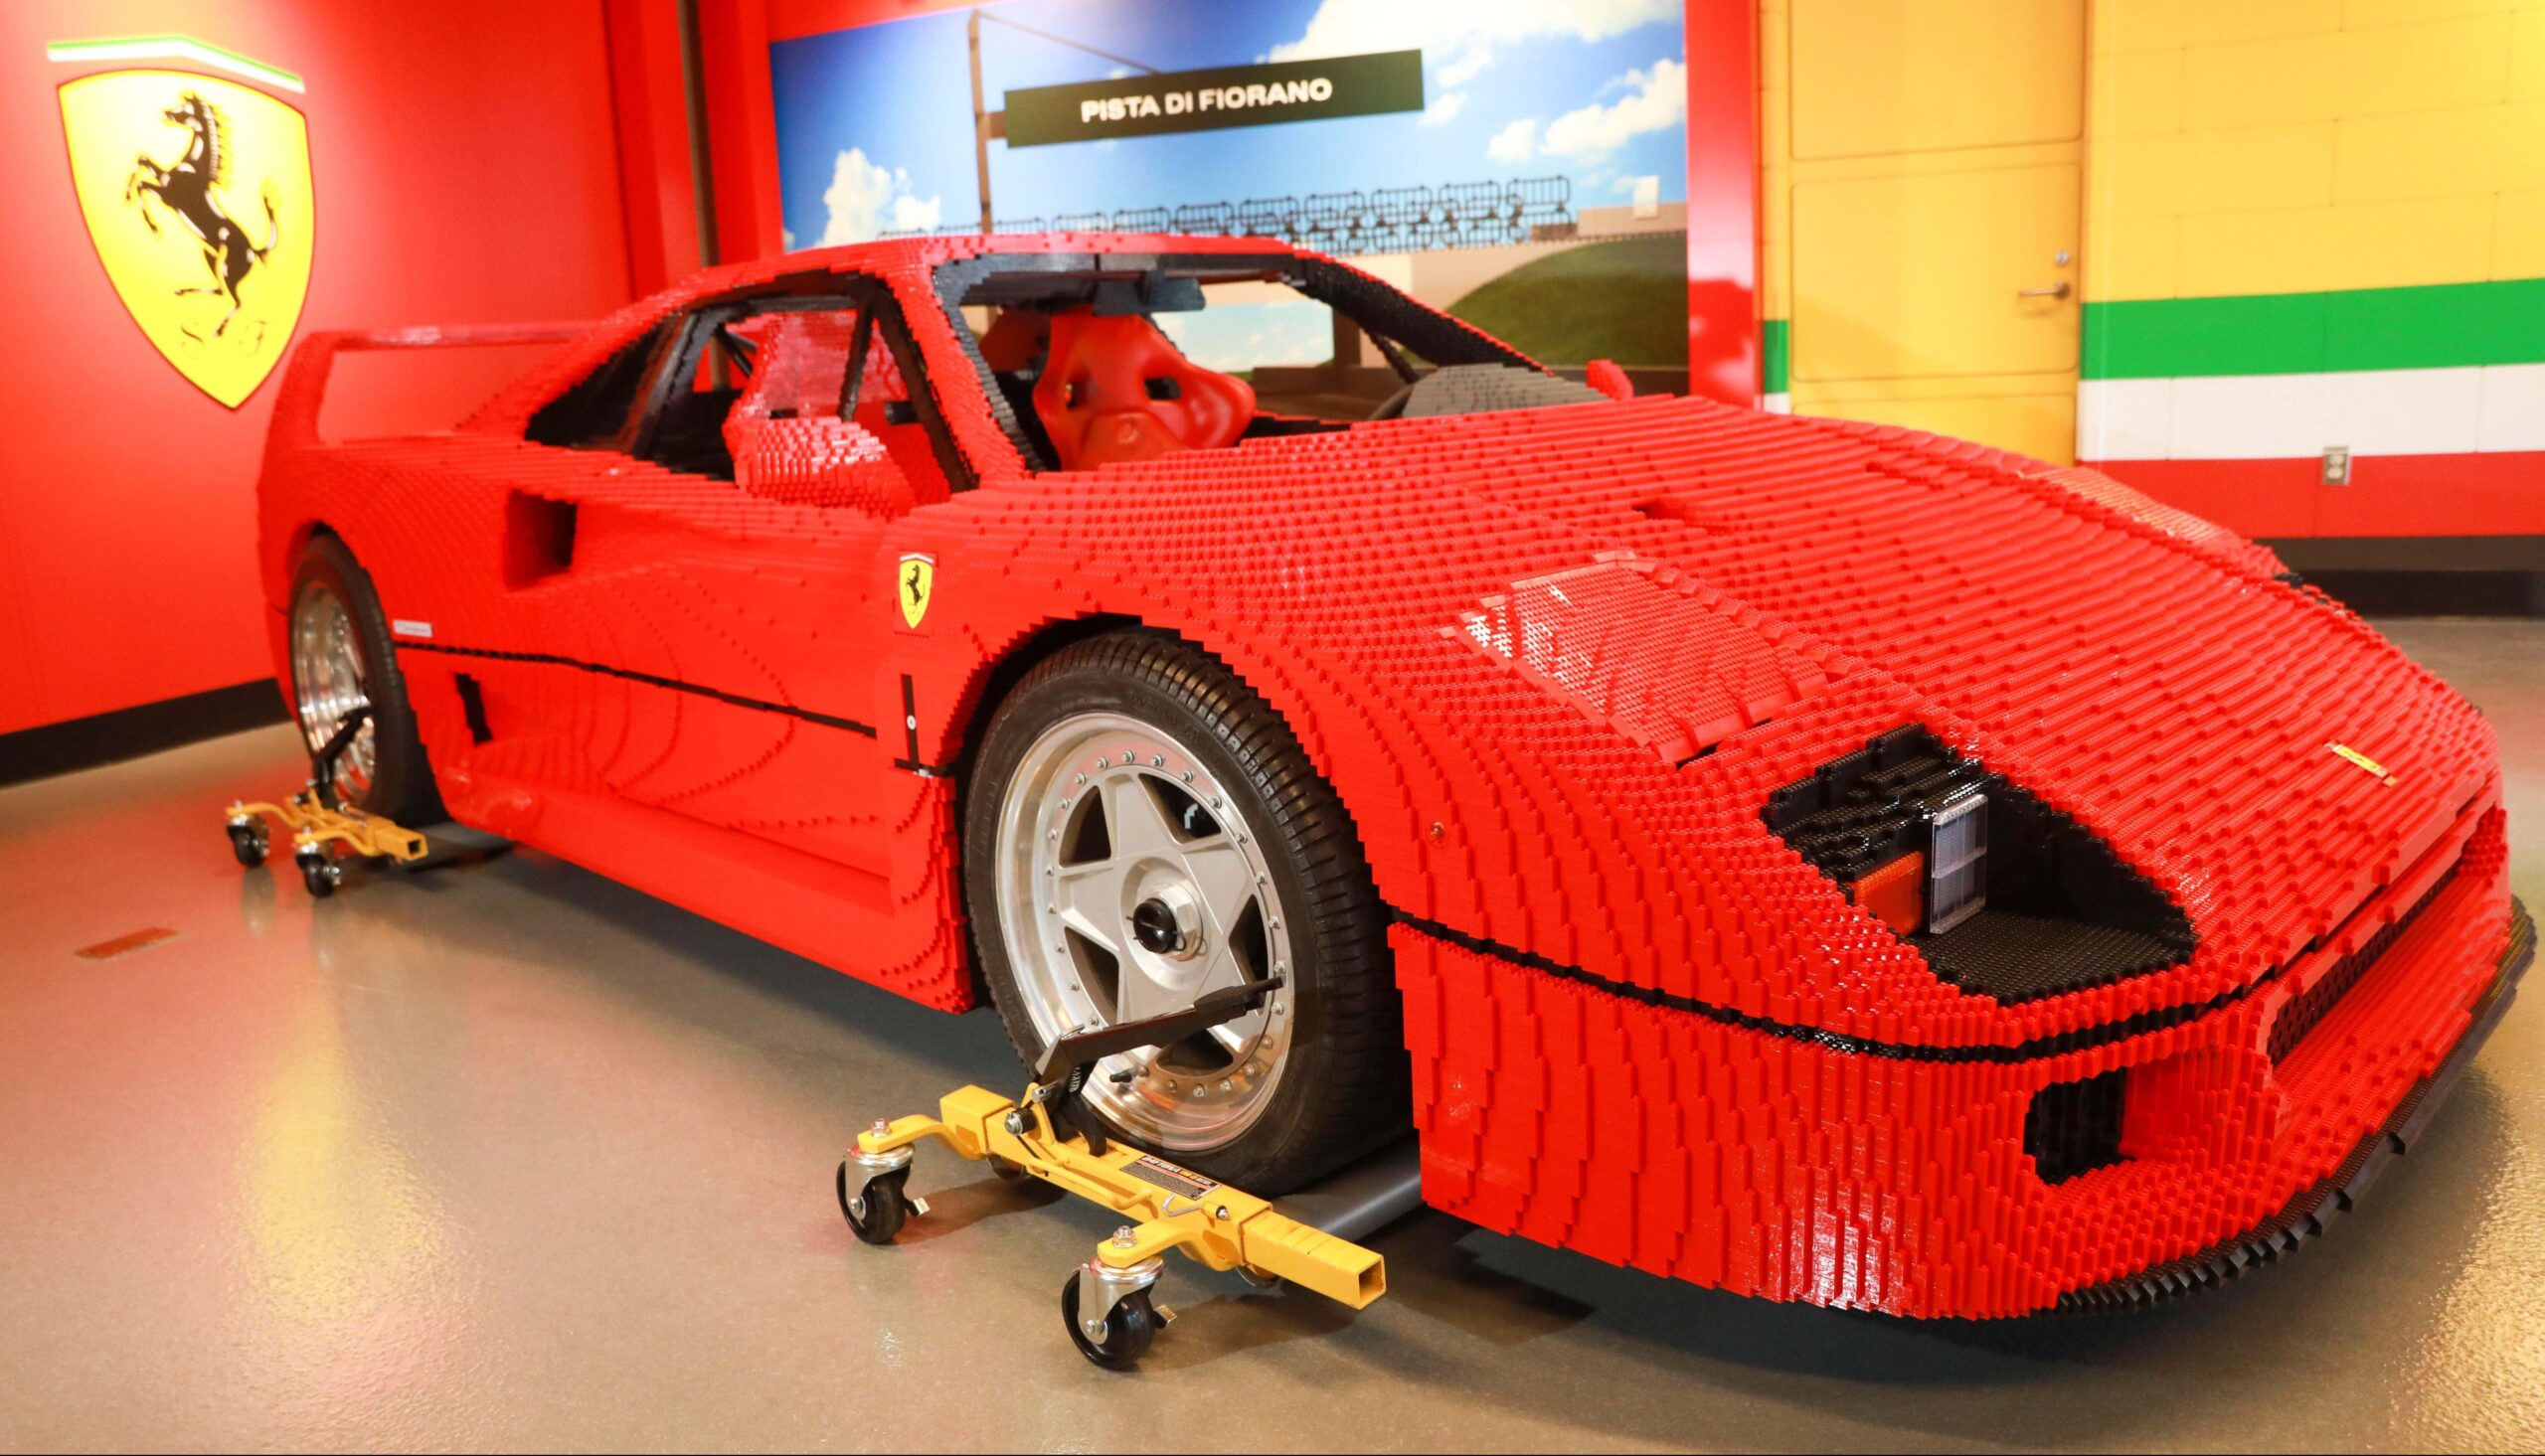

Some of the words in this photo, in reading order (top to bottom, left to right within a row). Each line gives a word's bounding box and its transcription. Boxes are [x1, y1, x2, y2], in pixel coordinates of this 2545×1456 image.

[1081, 94, 1161, 123] PISTA
[1164, 91, 1194, 115] DI
[1198, 78, 1333, 111] FIORANO
